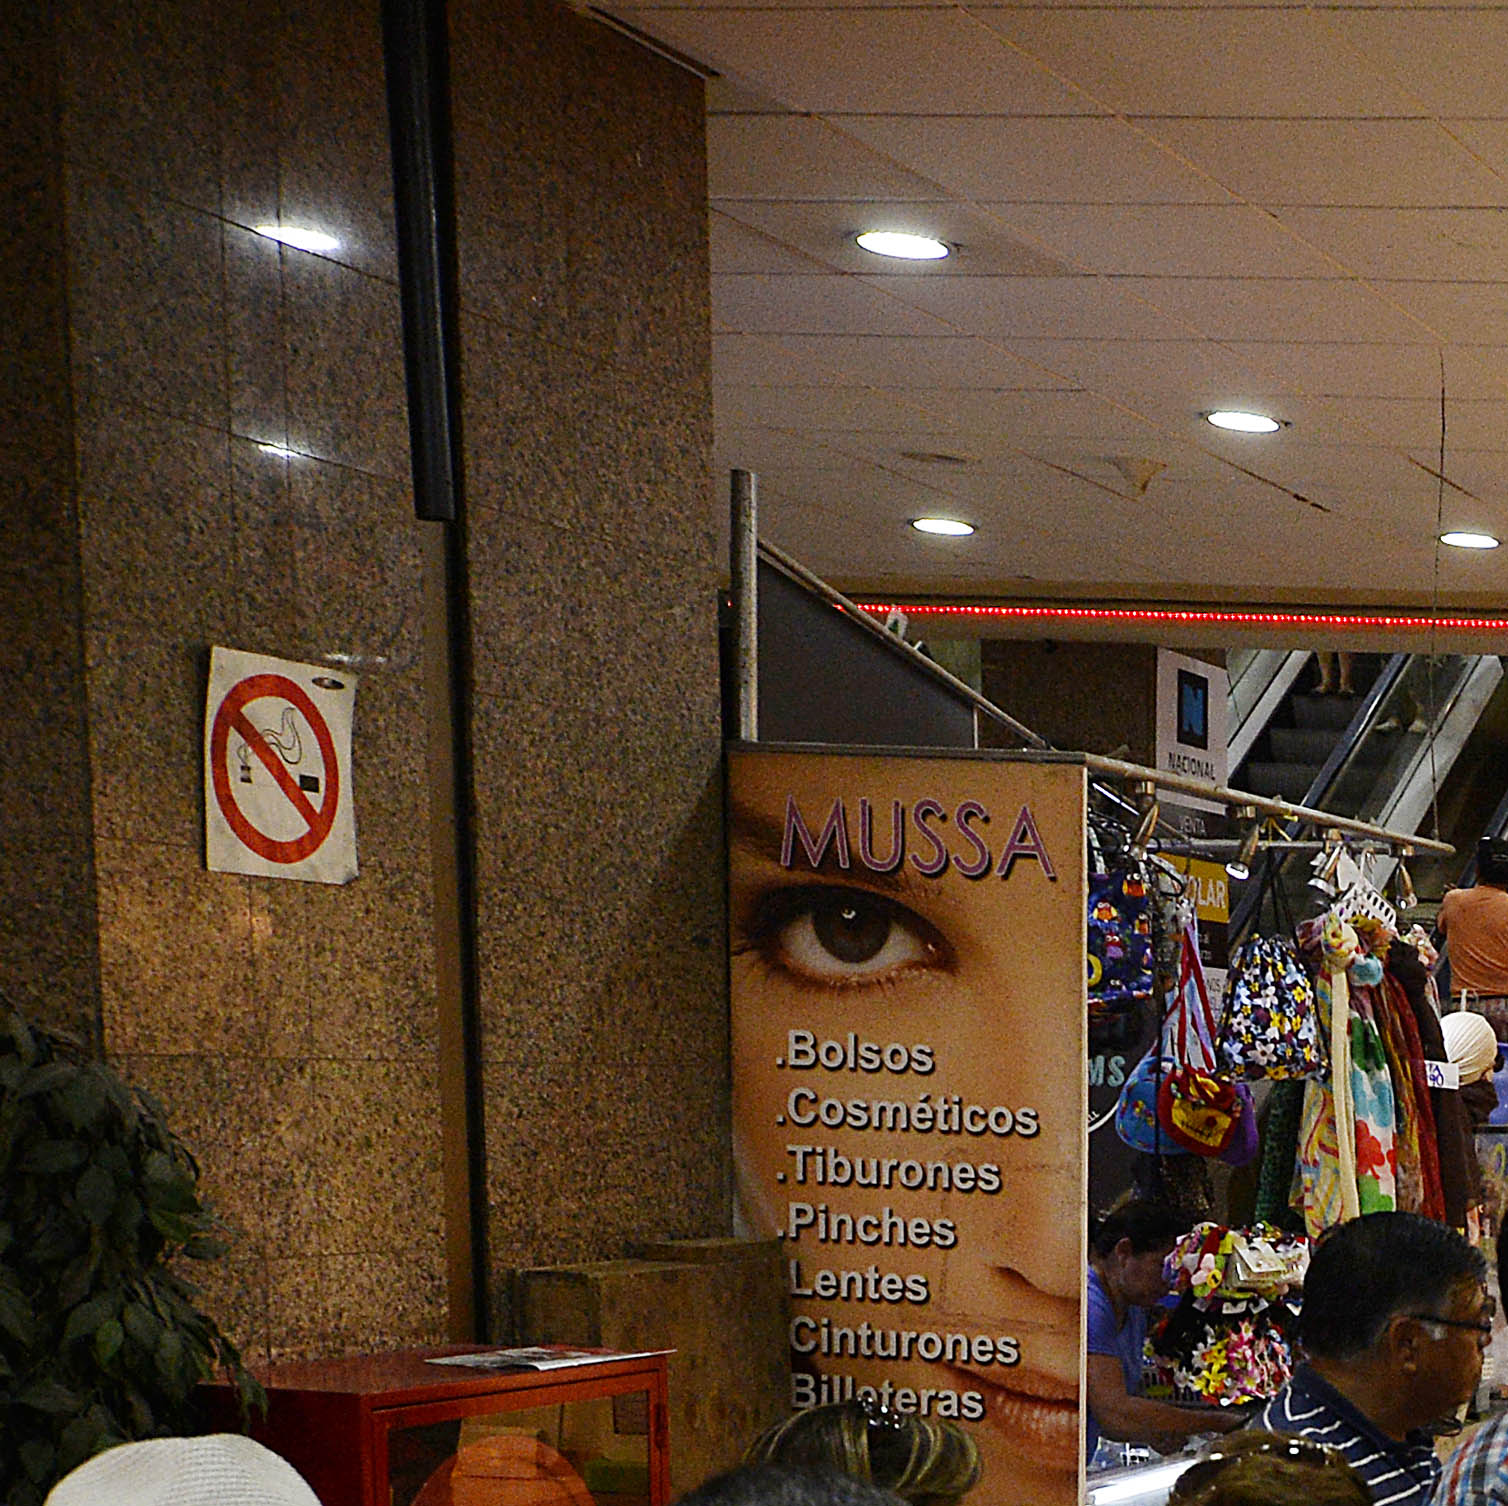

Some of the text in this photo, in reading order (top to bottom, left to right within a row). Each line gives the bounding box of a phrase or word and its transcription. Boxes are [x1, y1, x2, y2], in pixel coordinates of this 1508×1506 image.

[1168, 751, 1216, 781] NACIONAL
[778, 794, 1057, 880] MUSSA
[1186, 875, 1227, 909] OLAR
[789, 1259, 929, 1303] Lentes
[789, 1315, 1020, 1364] Cinturones
